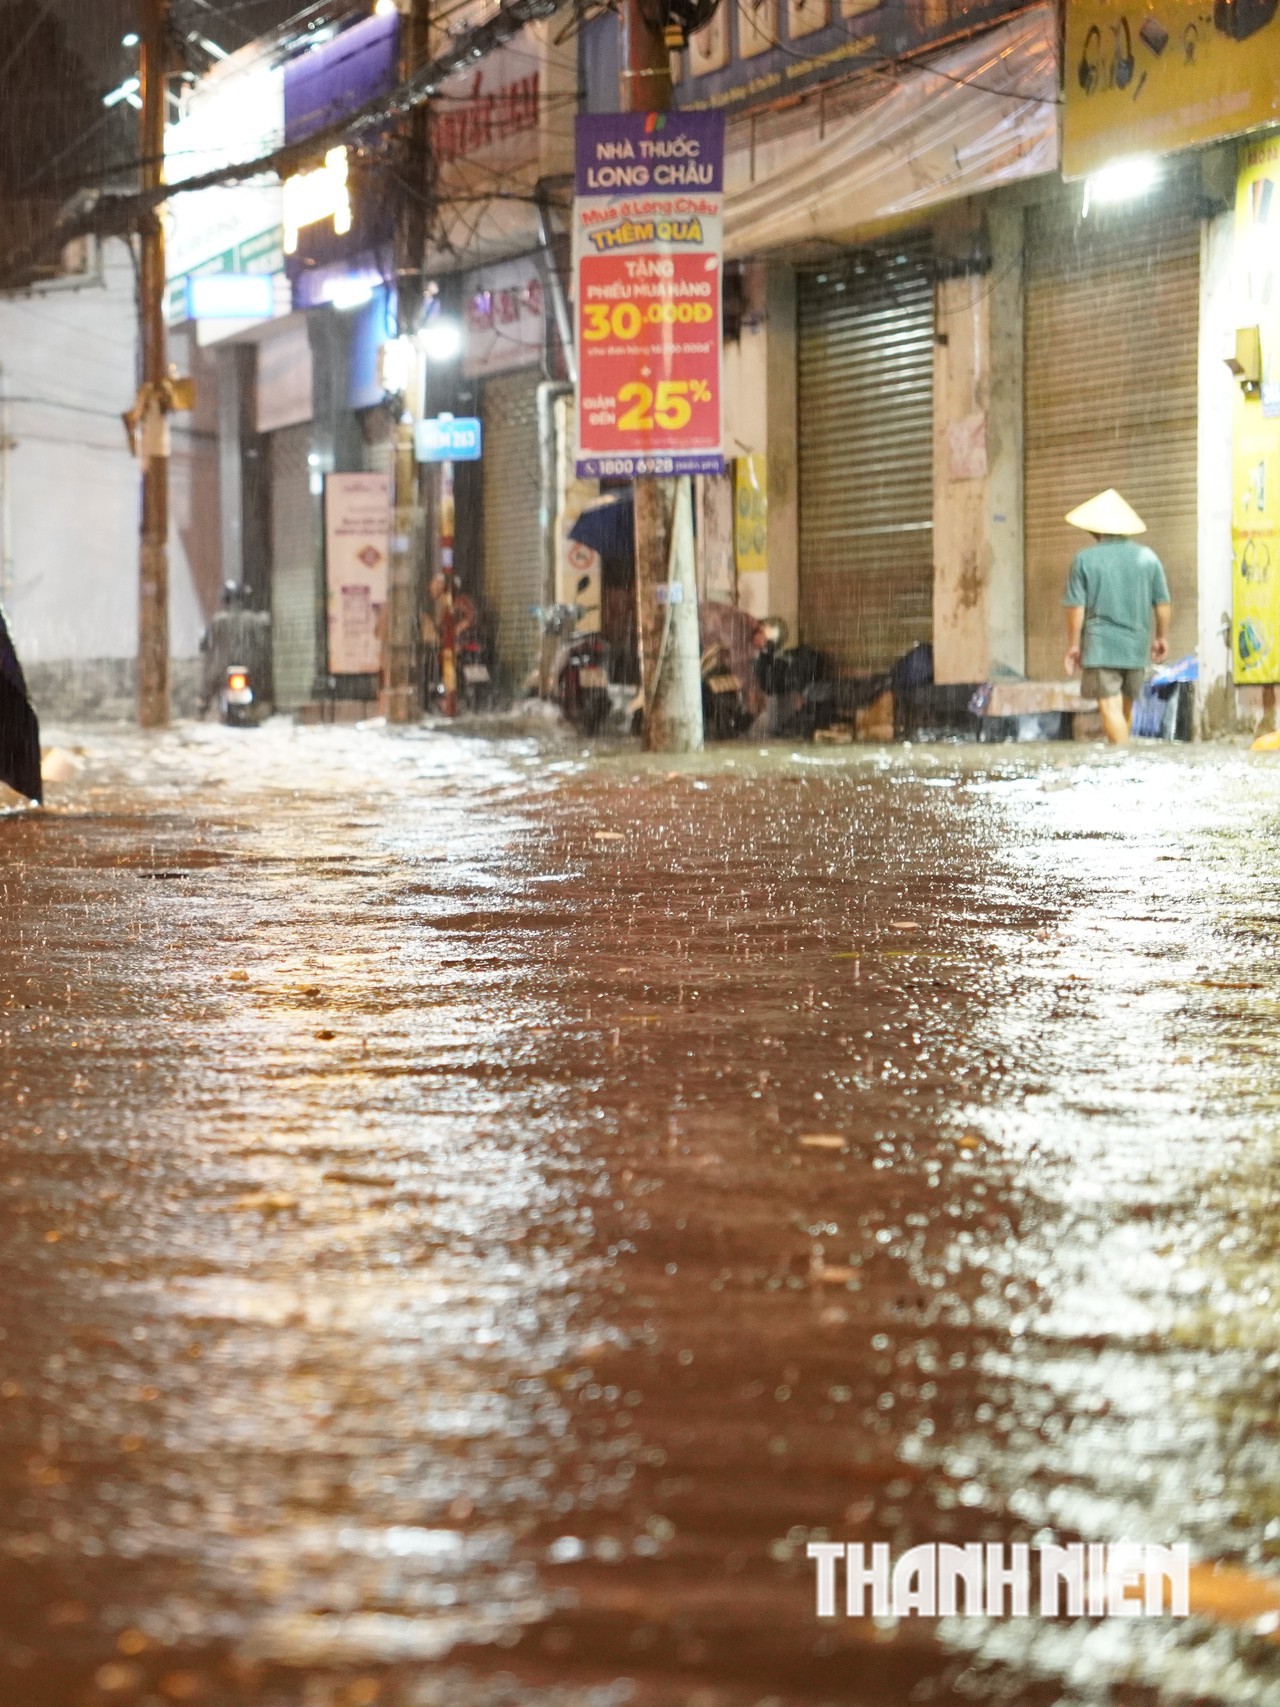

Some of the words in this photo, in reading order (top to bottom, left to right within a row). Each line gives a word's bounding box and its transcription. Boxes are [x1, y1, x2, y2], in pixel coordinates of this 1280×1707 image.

[596, 137, 635, 160] NHÀ
[639, 133, 700, 158] THUỐC
[587, 166, 650, 189] LONG
[654, 159, 713, 186] CHÂU
[582, 208, 618, 227] Mua
[633, 200, 673, 216] Long
[590, 219, 655, 250] THÊM
[656, 217, 703, 243] QUÀ
[587, 278, 631, 299] PHIẾU
[633, 282, 666, 298] MUA
[618, 378, 712, 430] 25%
[601, 458, 634, 475] 1800
[636, 456, 674, 474] 6928
